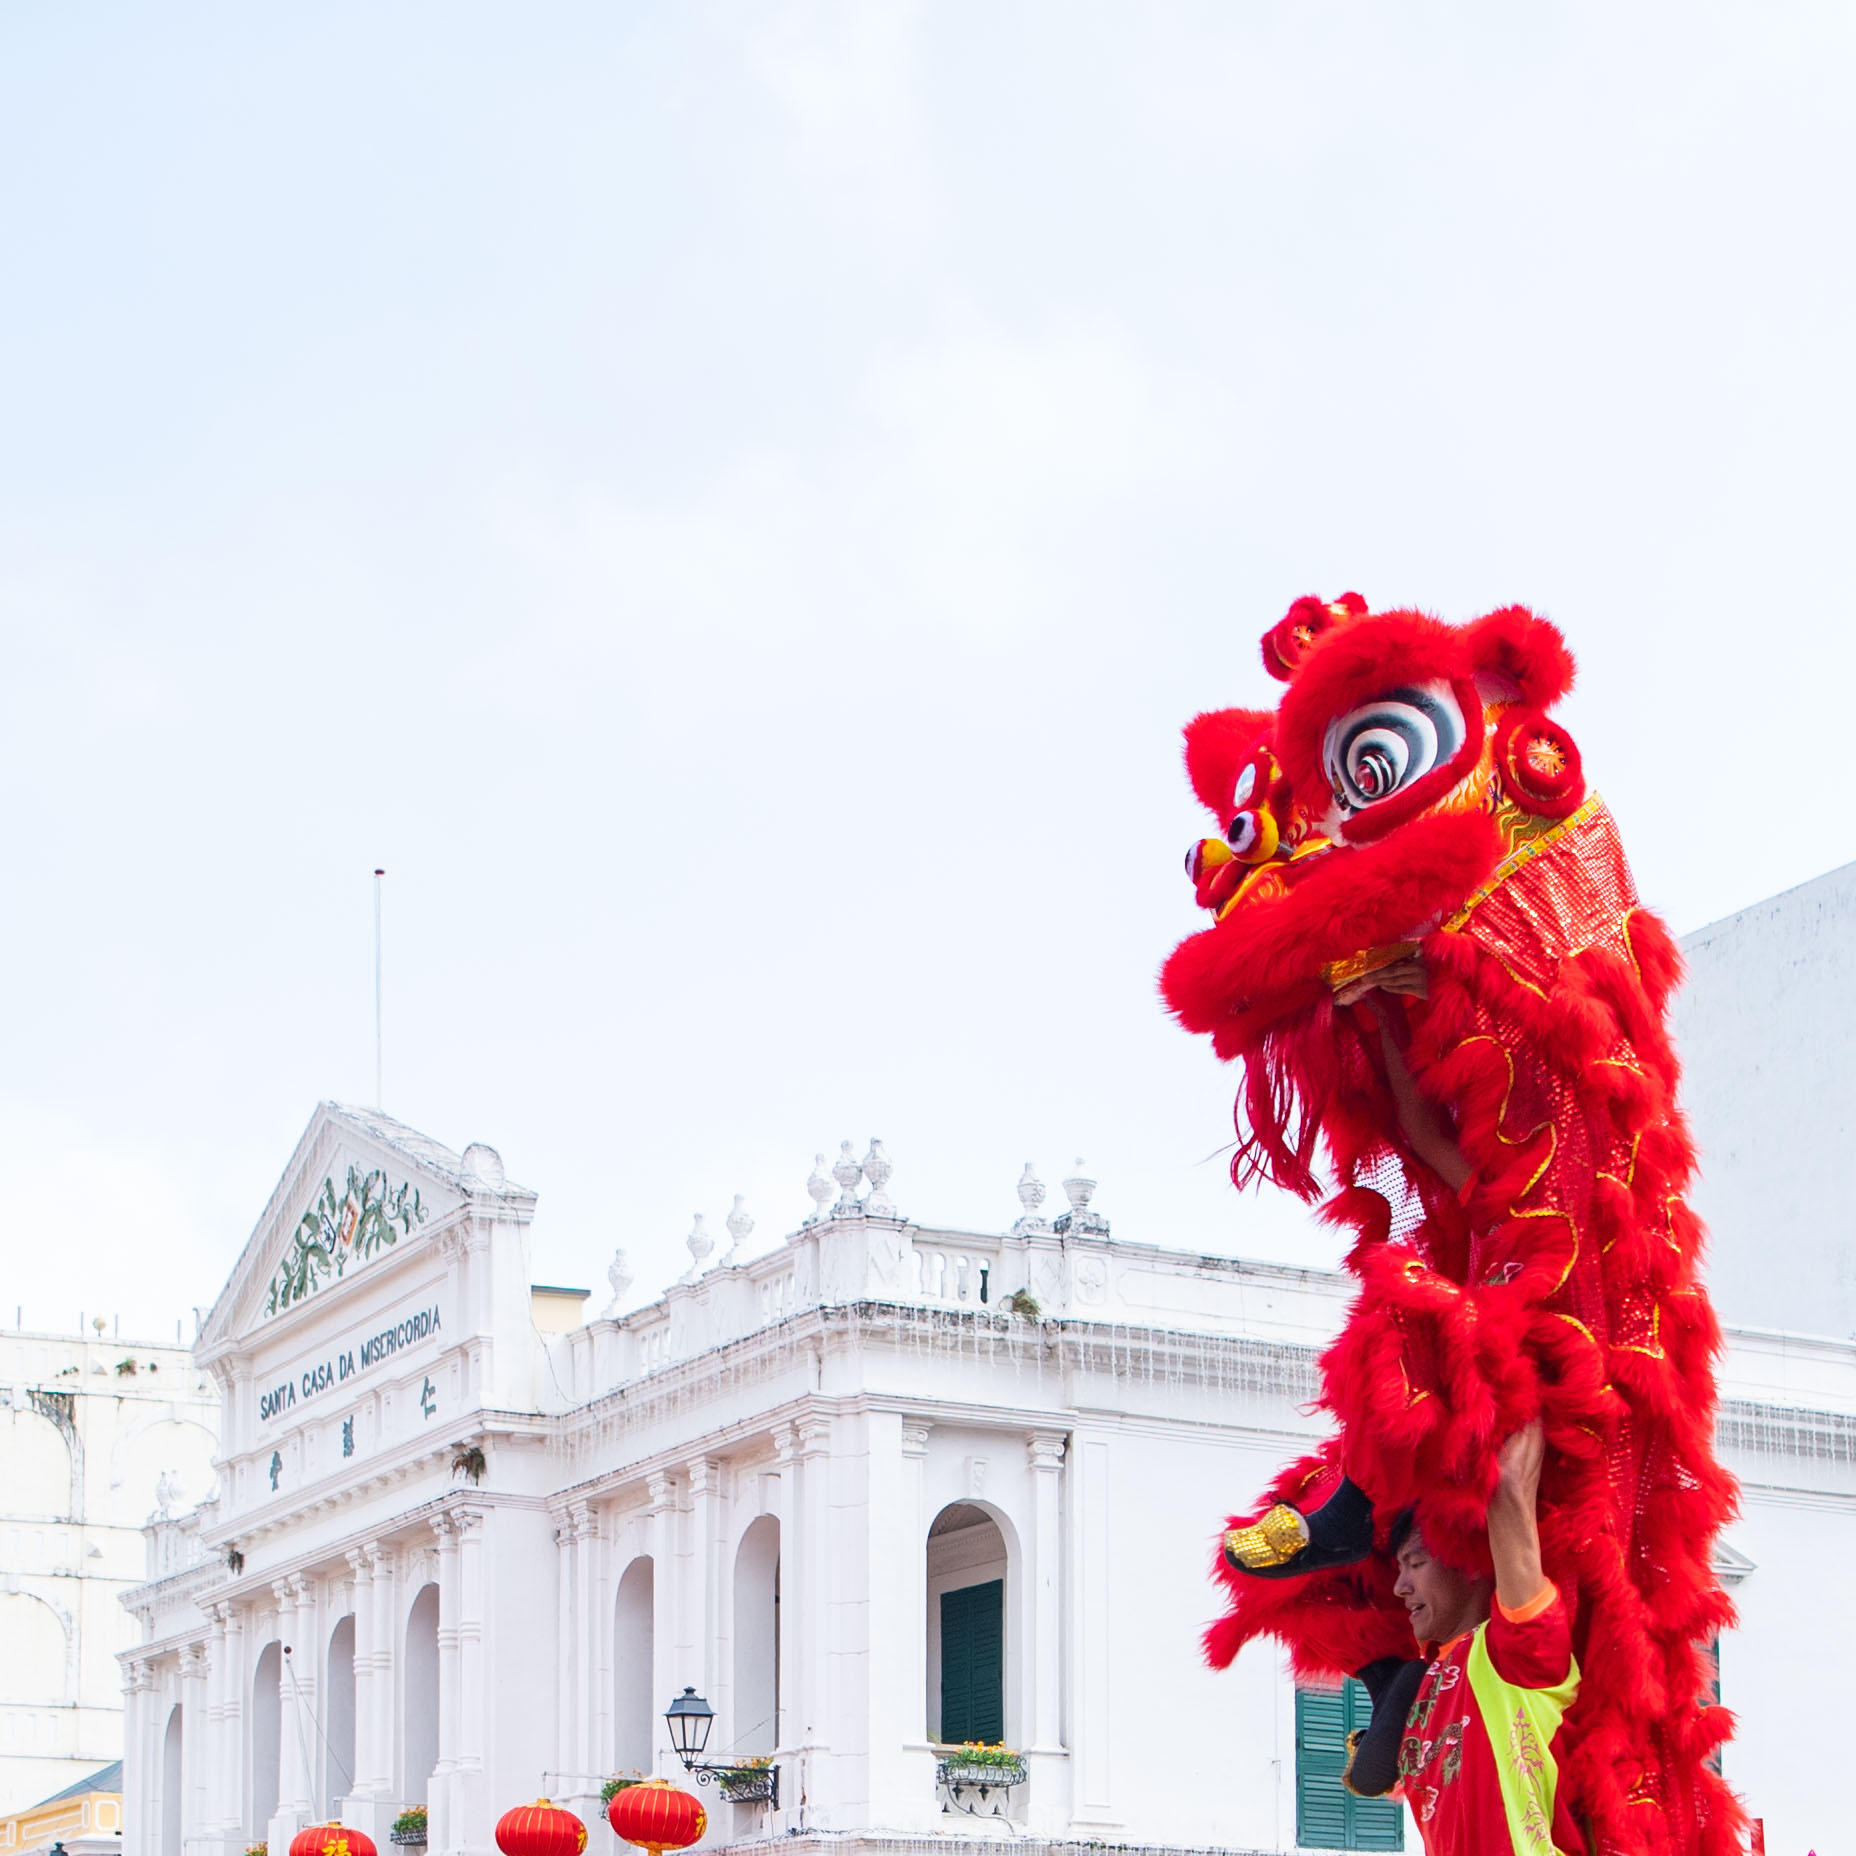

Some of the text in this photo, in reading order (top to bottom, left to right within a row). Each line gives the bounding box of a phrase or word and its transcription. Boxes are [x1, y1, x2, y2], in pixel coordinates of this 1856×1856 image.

[260, 1304, 442, 1421] SANTA CASA DA MISERICORDIA
